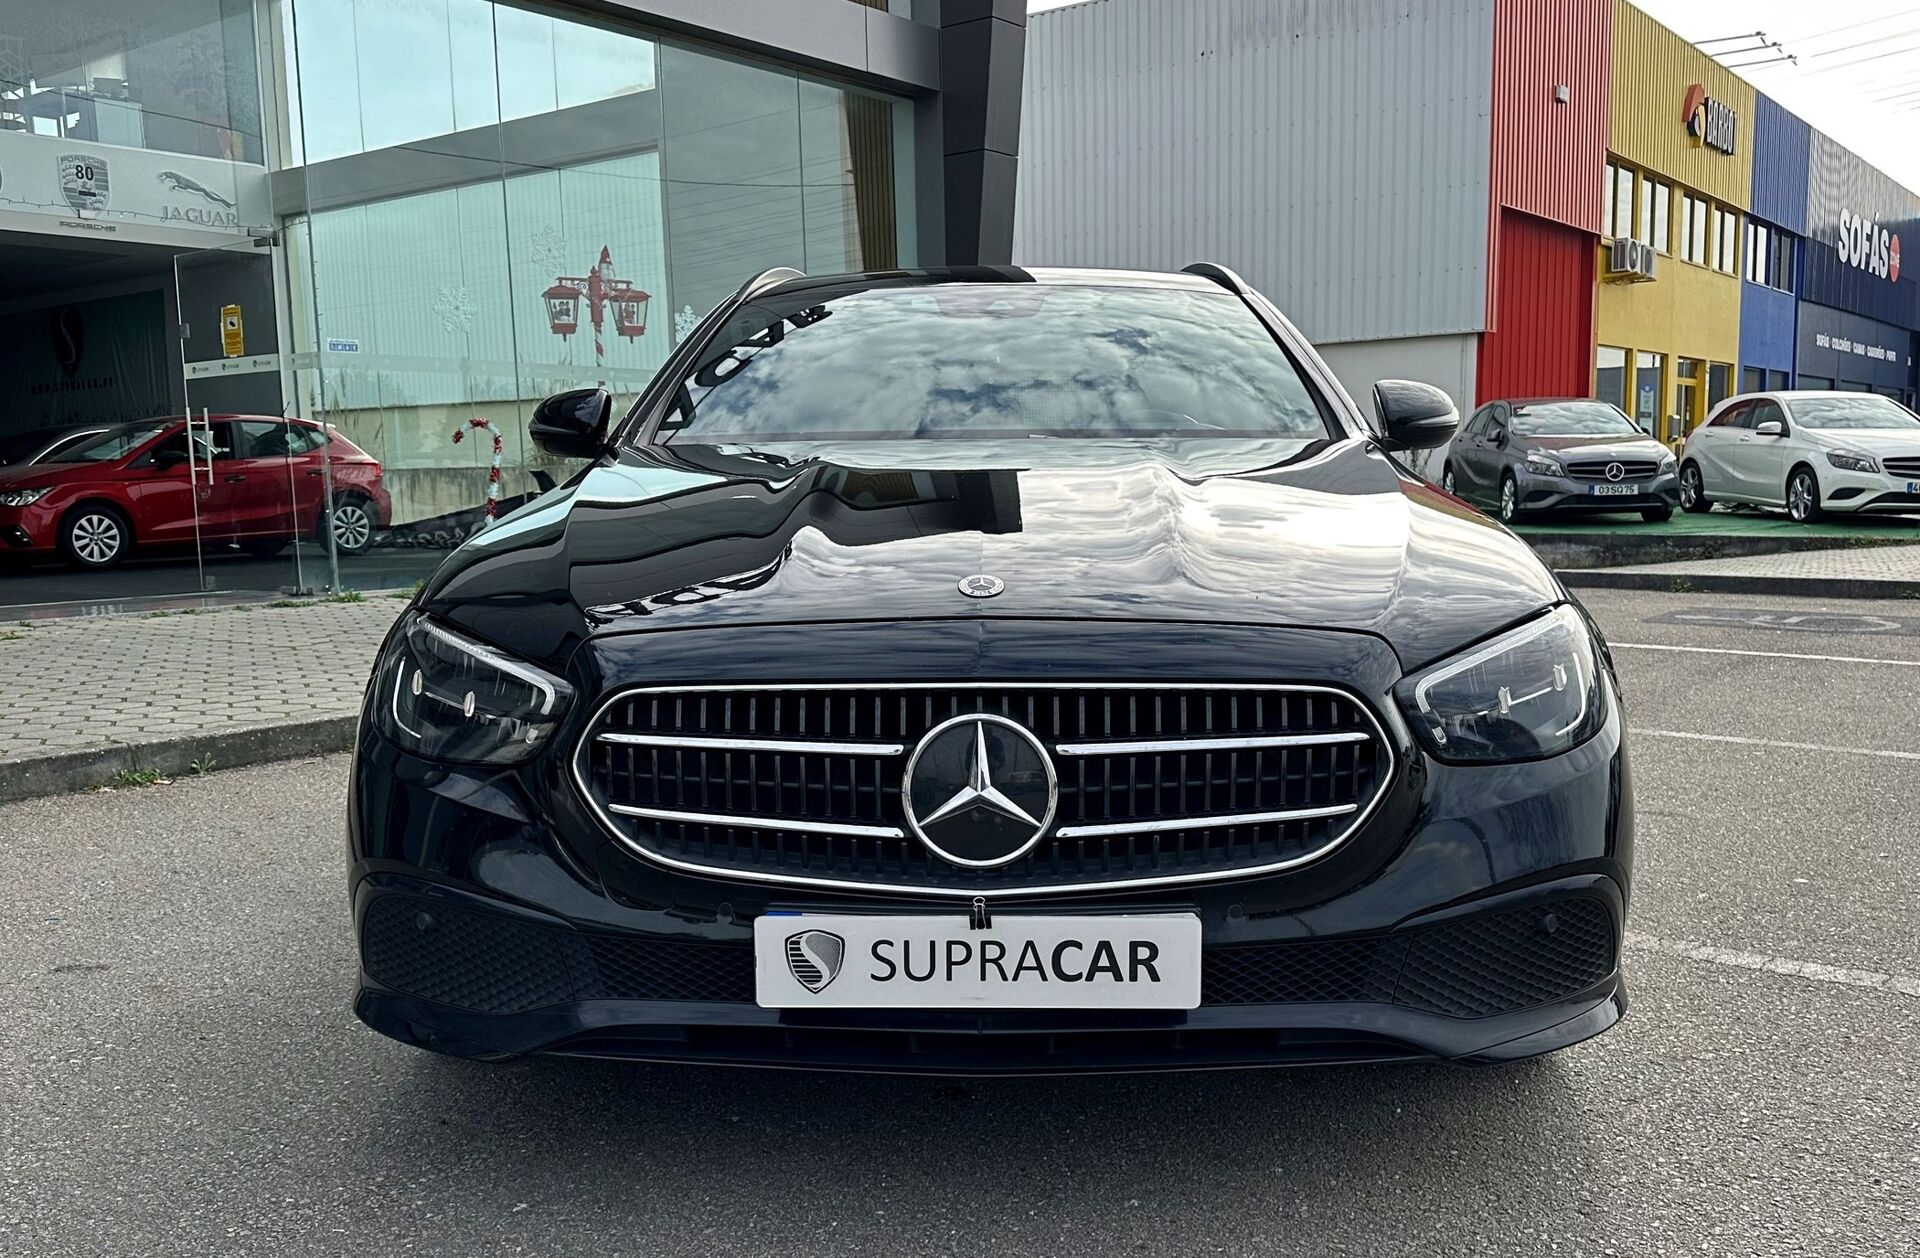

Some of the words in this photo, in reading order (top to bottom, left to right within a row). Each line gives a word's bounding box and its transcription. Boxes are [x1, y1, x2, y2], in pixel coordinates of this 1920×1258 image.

[75, 164, 94, 181] 80
[160, 204, 239, 227] JAGUAR
[1838, 207, 1889, 279] SOFÁS
[870, 939, 1161, 983] SUPRACAR
